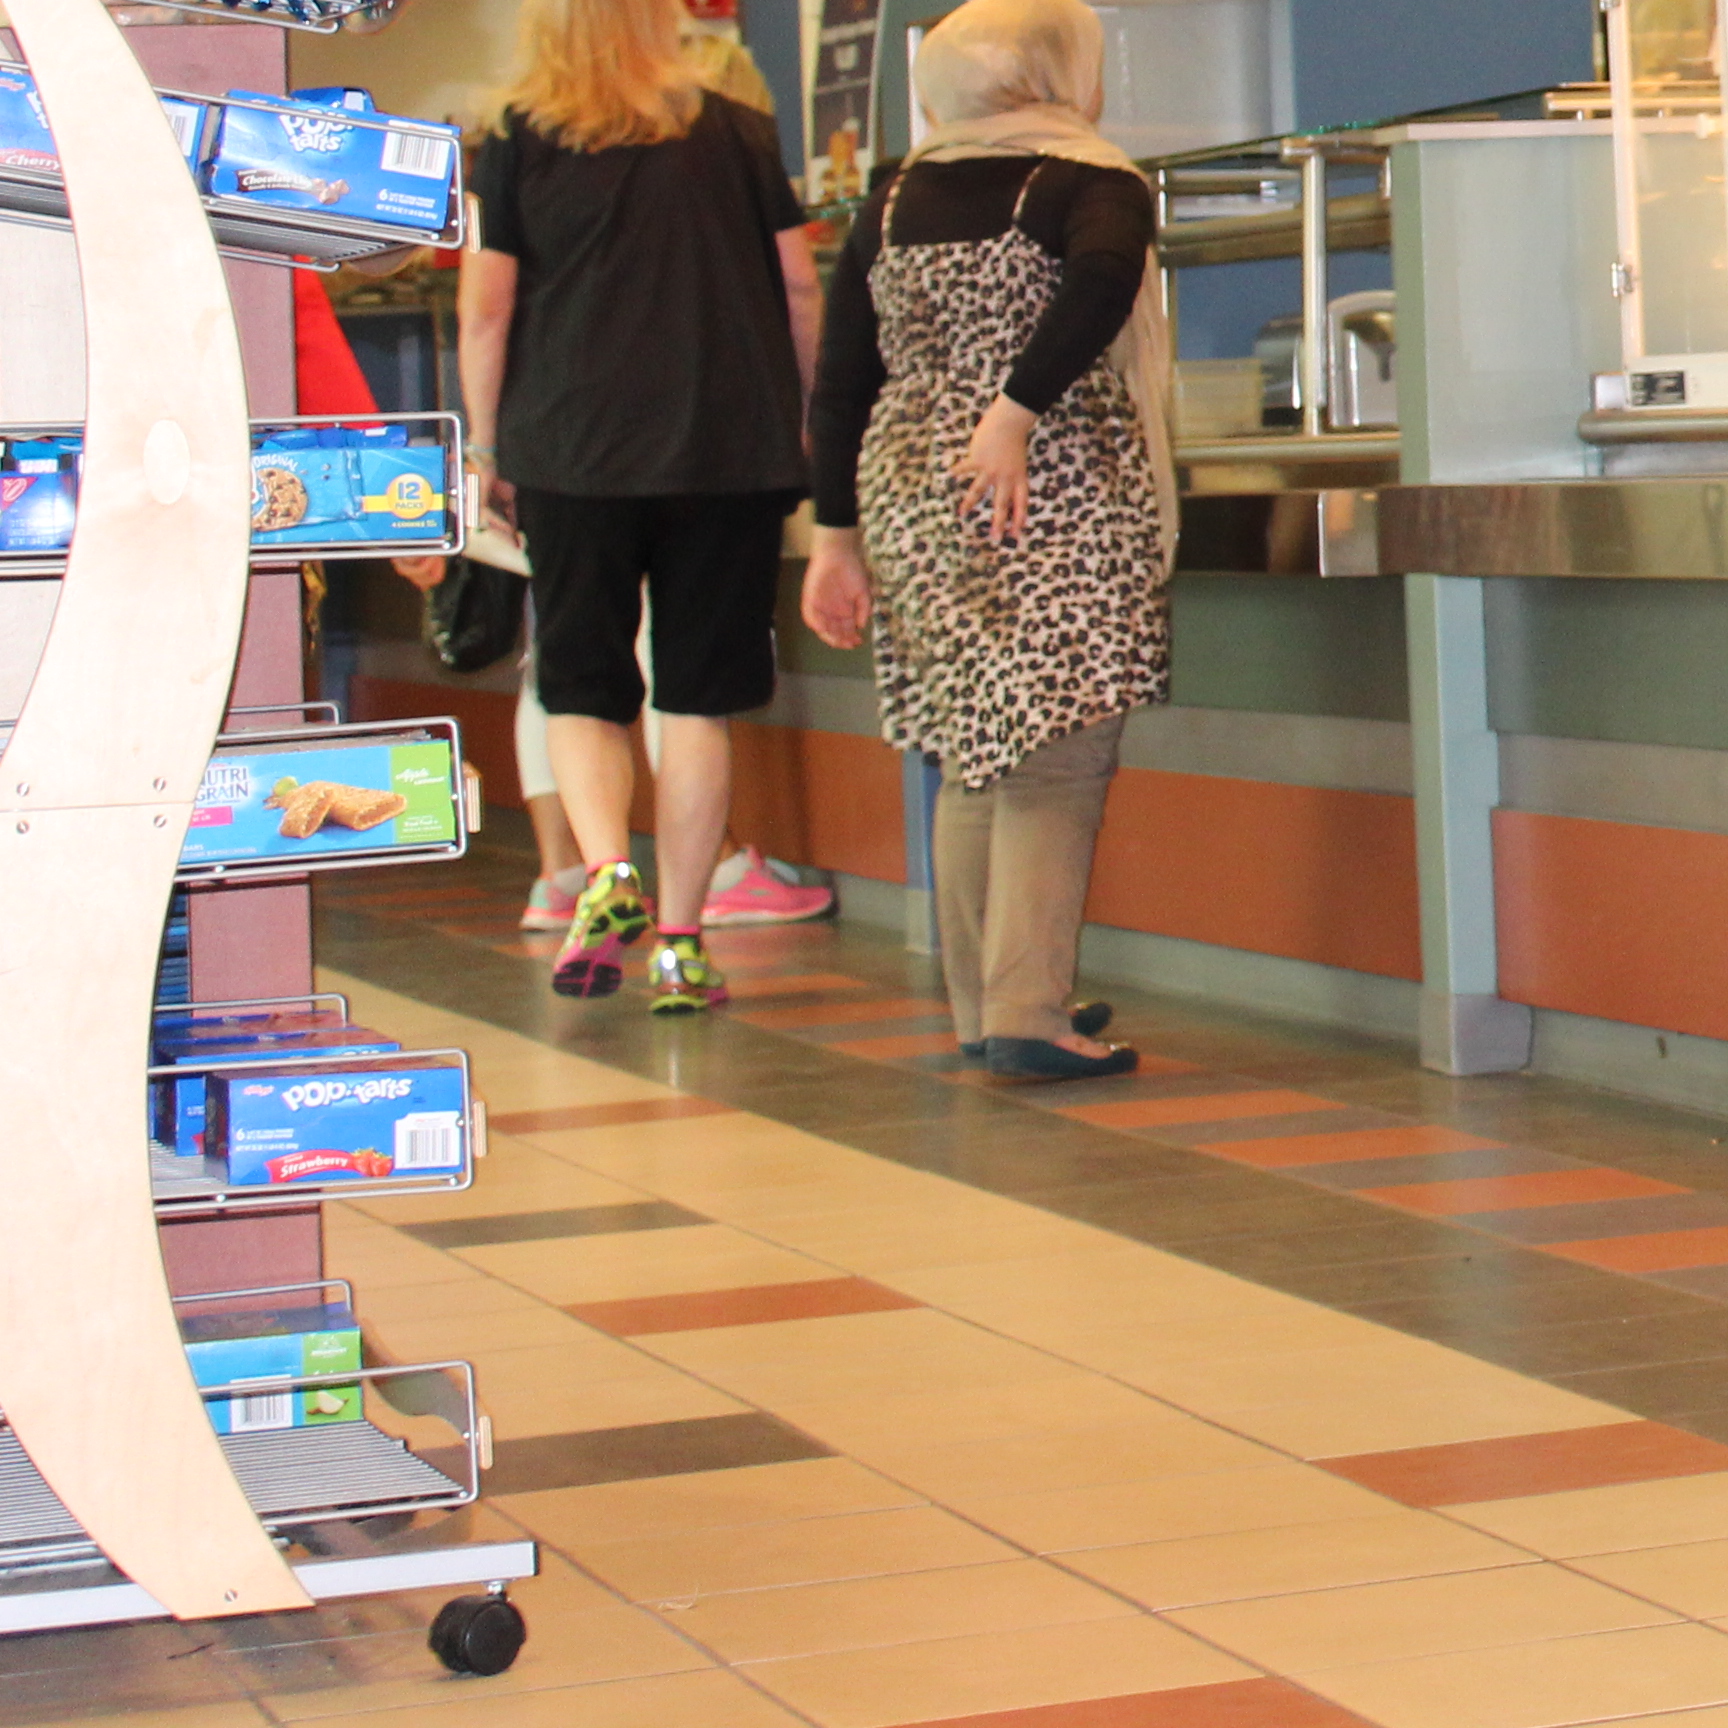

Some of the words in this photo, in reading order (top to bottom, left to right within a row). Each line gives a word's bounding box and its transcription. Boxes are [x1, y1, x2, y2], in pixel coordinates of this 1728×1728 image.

[5, 154, 60, 171] Cherry
[379, 188, 389, 201] 6
[253, 453, 300, 472] ORIGINAL
[397, 481, 421, 501] 12
[236, 1128, 246, 1141] 6
[279, 1155, 349, 1178] Strawberry
